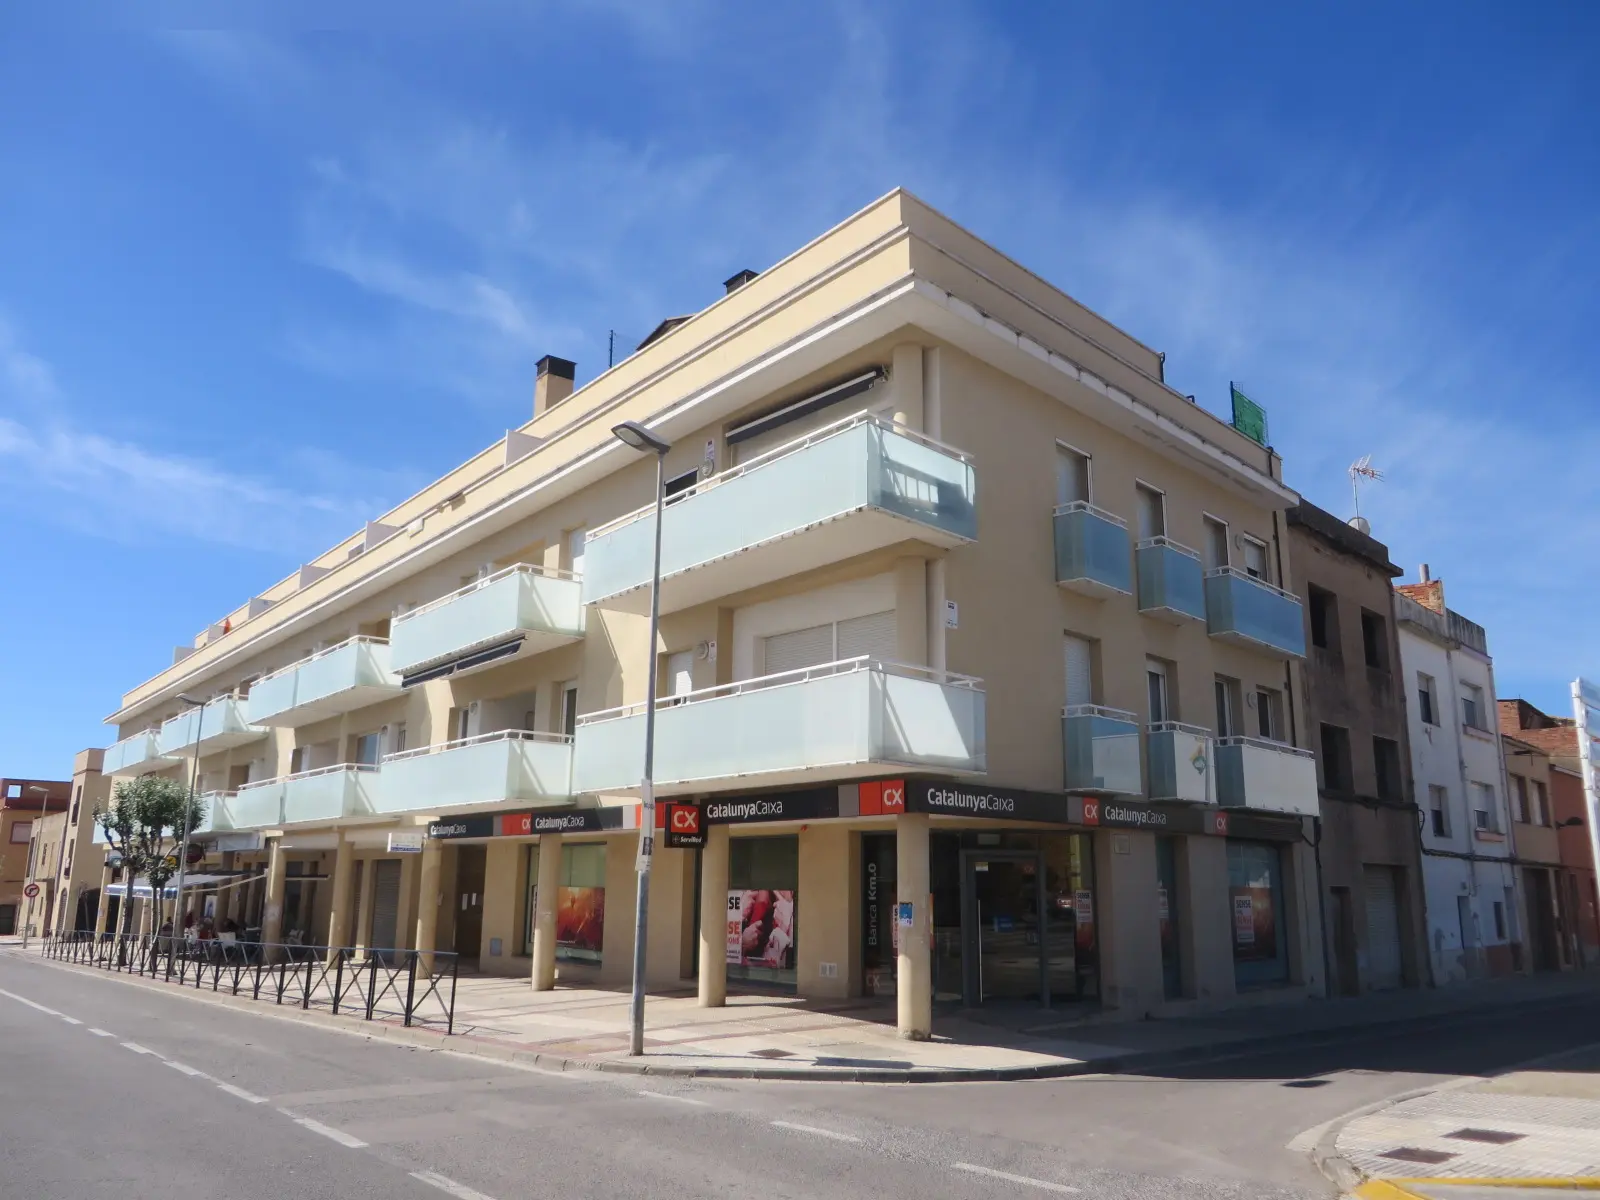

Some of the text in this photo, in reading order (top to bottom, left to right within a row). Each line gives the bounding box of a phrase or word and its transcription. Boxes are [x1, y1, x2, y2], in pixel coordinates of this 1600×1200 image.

[883, 788, 903, 806] CX
[927, 788, 1015, 812] CatalunyaCaixa
[707, 800, 783, 819] CatalunyaCaixa
[1084, 804, 1098, 819] CX
[1105, 805, 1167, 825] CatalunyaCaixa
[535, 815, 585, 830] CatalunyaCaixa
[673, 810, 697, 828] CX
[1216, 817, 1226, 830] CX
[430, 823, 467, 837] CatalunyaCaixa
[868, 904, 877, 946] Banca
